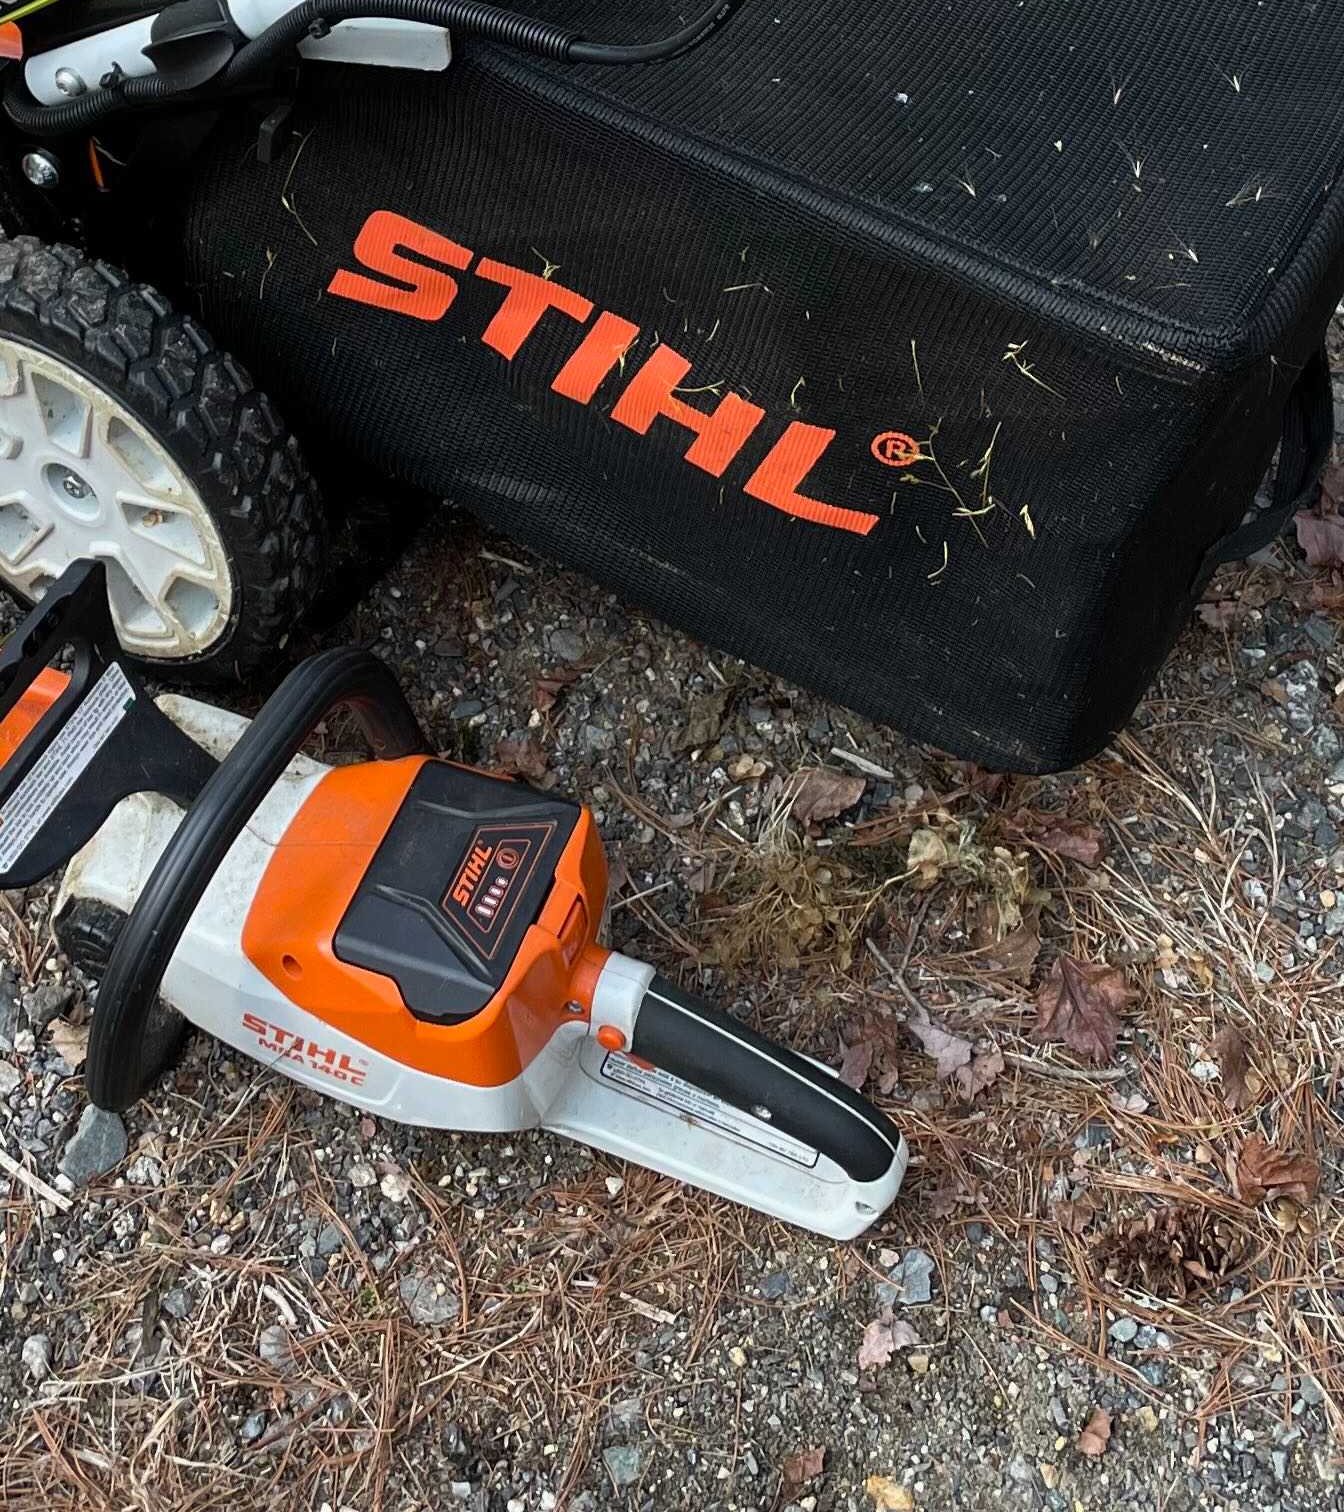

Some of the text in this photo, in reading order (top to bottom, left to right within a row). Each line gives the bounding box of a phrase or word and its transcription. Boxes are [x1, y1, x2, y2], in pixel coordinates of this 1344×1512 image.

[327, 210, 880, 535] STIHL
[452, 845, 493, 907] STIHL
[242, 1013, 367, 1077] STIHL
